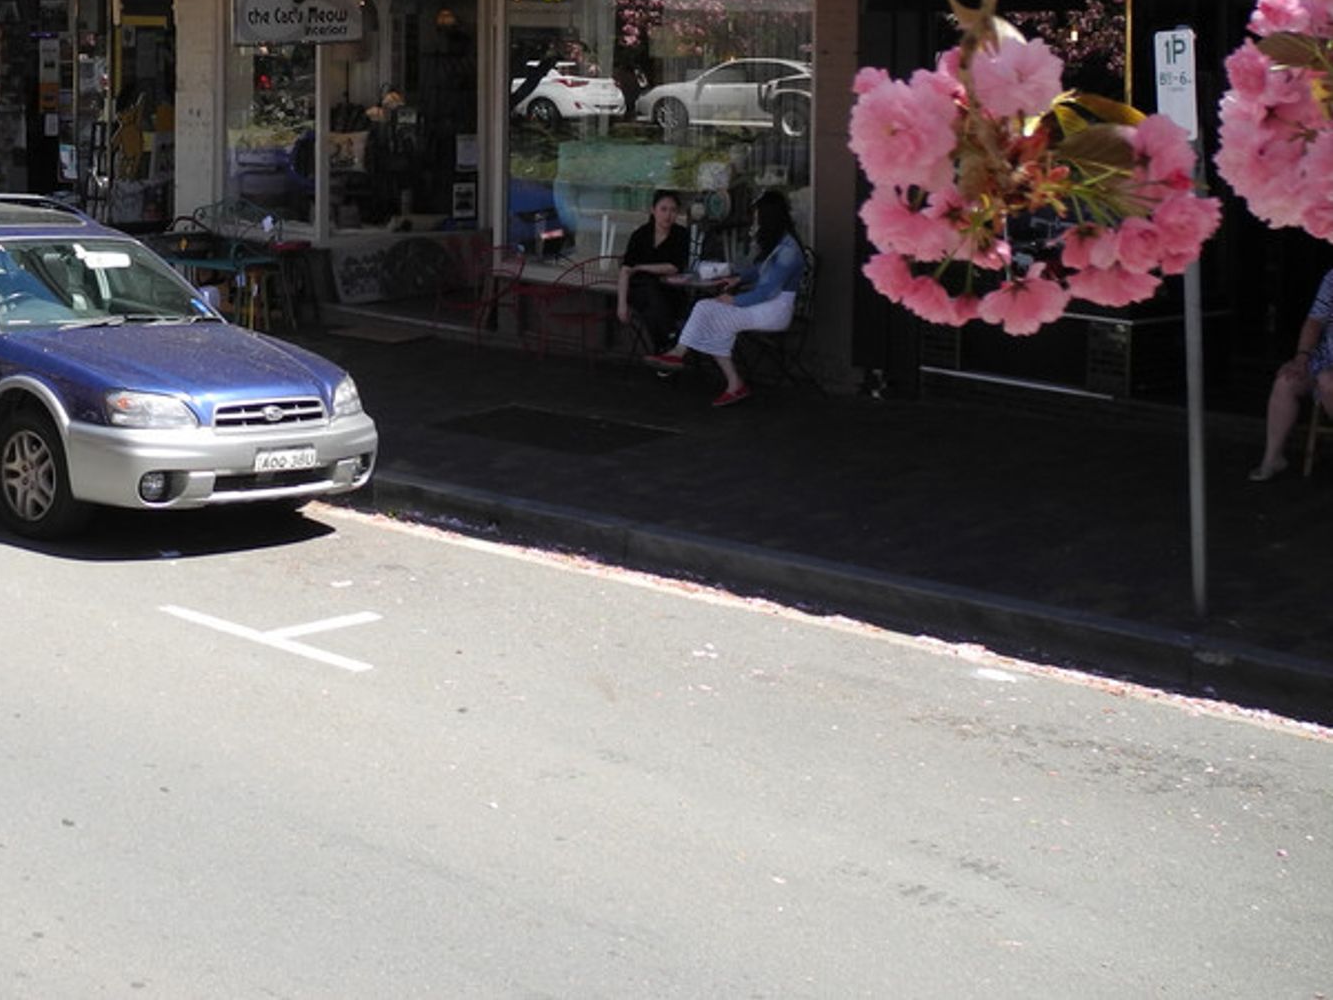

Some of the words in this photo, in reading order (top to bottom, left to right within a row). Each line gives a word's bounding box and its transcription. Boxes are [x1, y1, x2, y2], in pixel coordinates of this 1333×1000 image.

[248, 7, 270, 25] the
[308, 7, 348, 23] Meow
[1165, 34, 1186, 64] 1P
